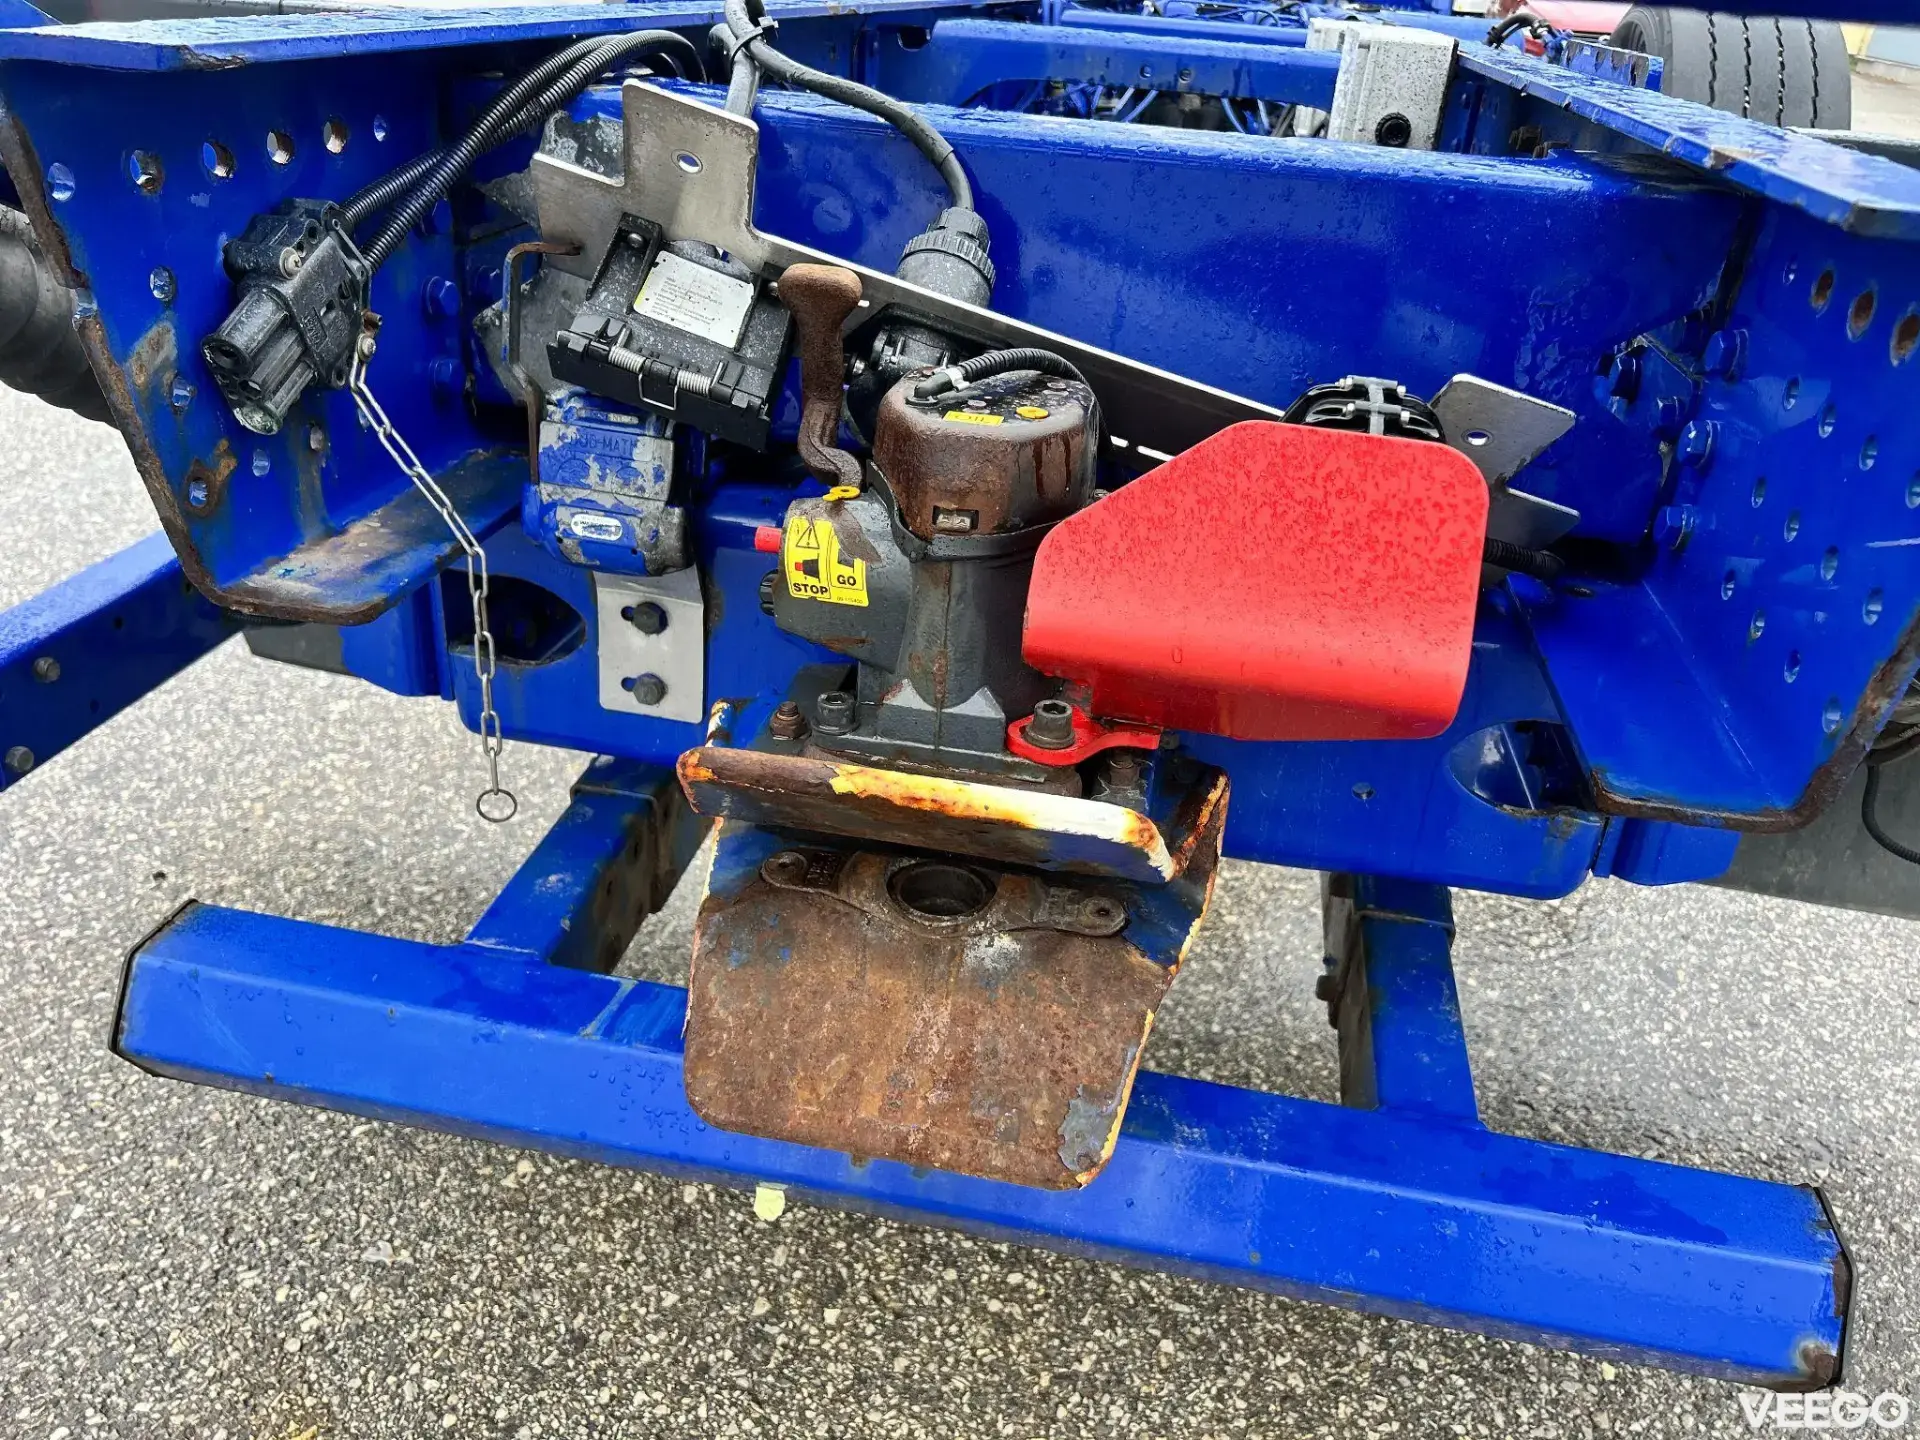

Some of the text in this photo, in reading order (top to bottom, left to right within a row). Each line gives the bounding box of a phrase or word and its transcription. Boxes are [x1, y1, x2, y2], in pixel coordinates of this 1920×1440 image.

[954, 414, 990, 424] OIL
[836, 574, 857, 587] GO
[793, 582, 829, 595] STOP
